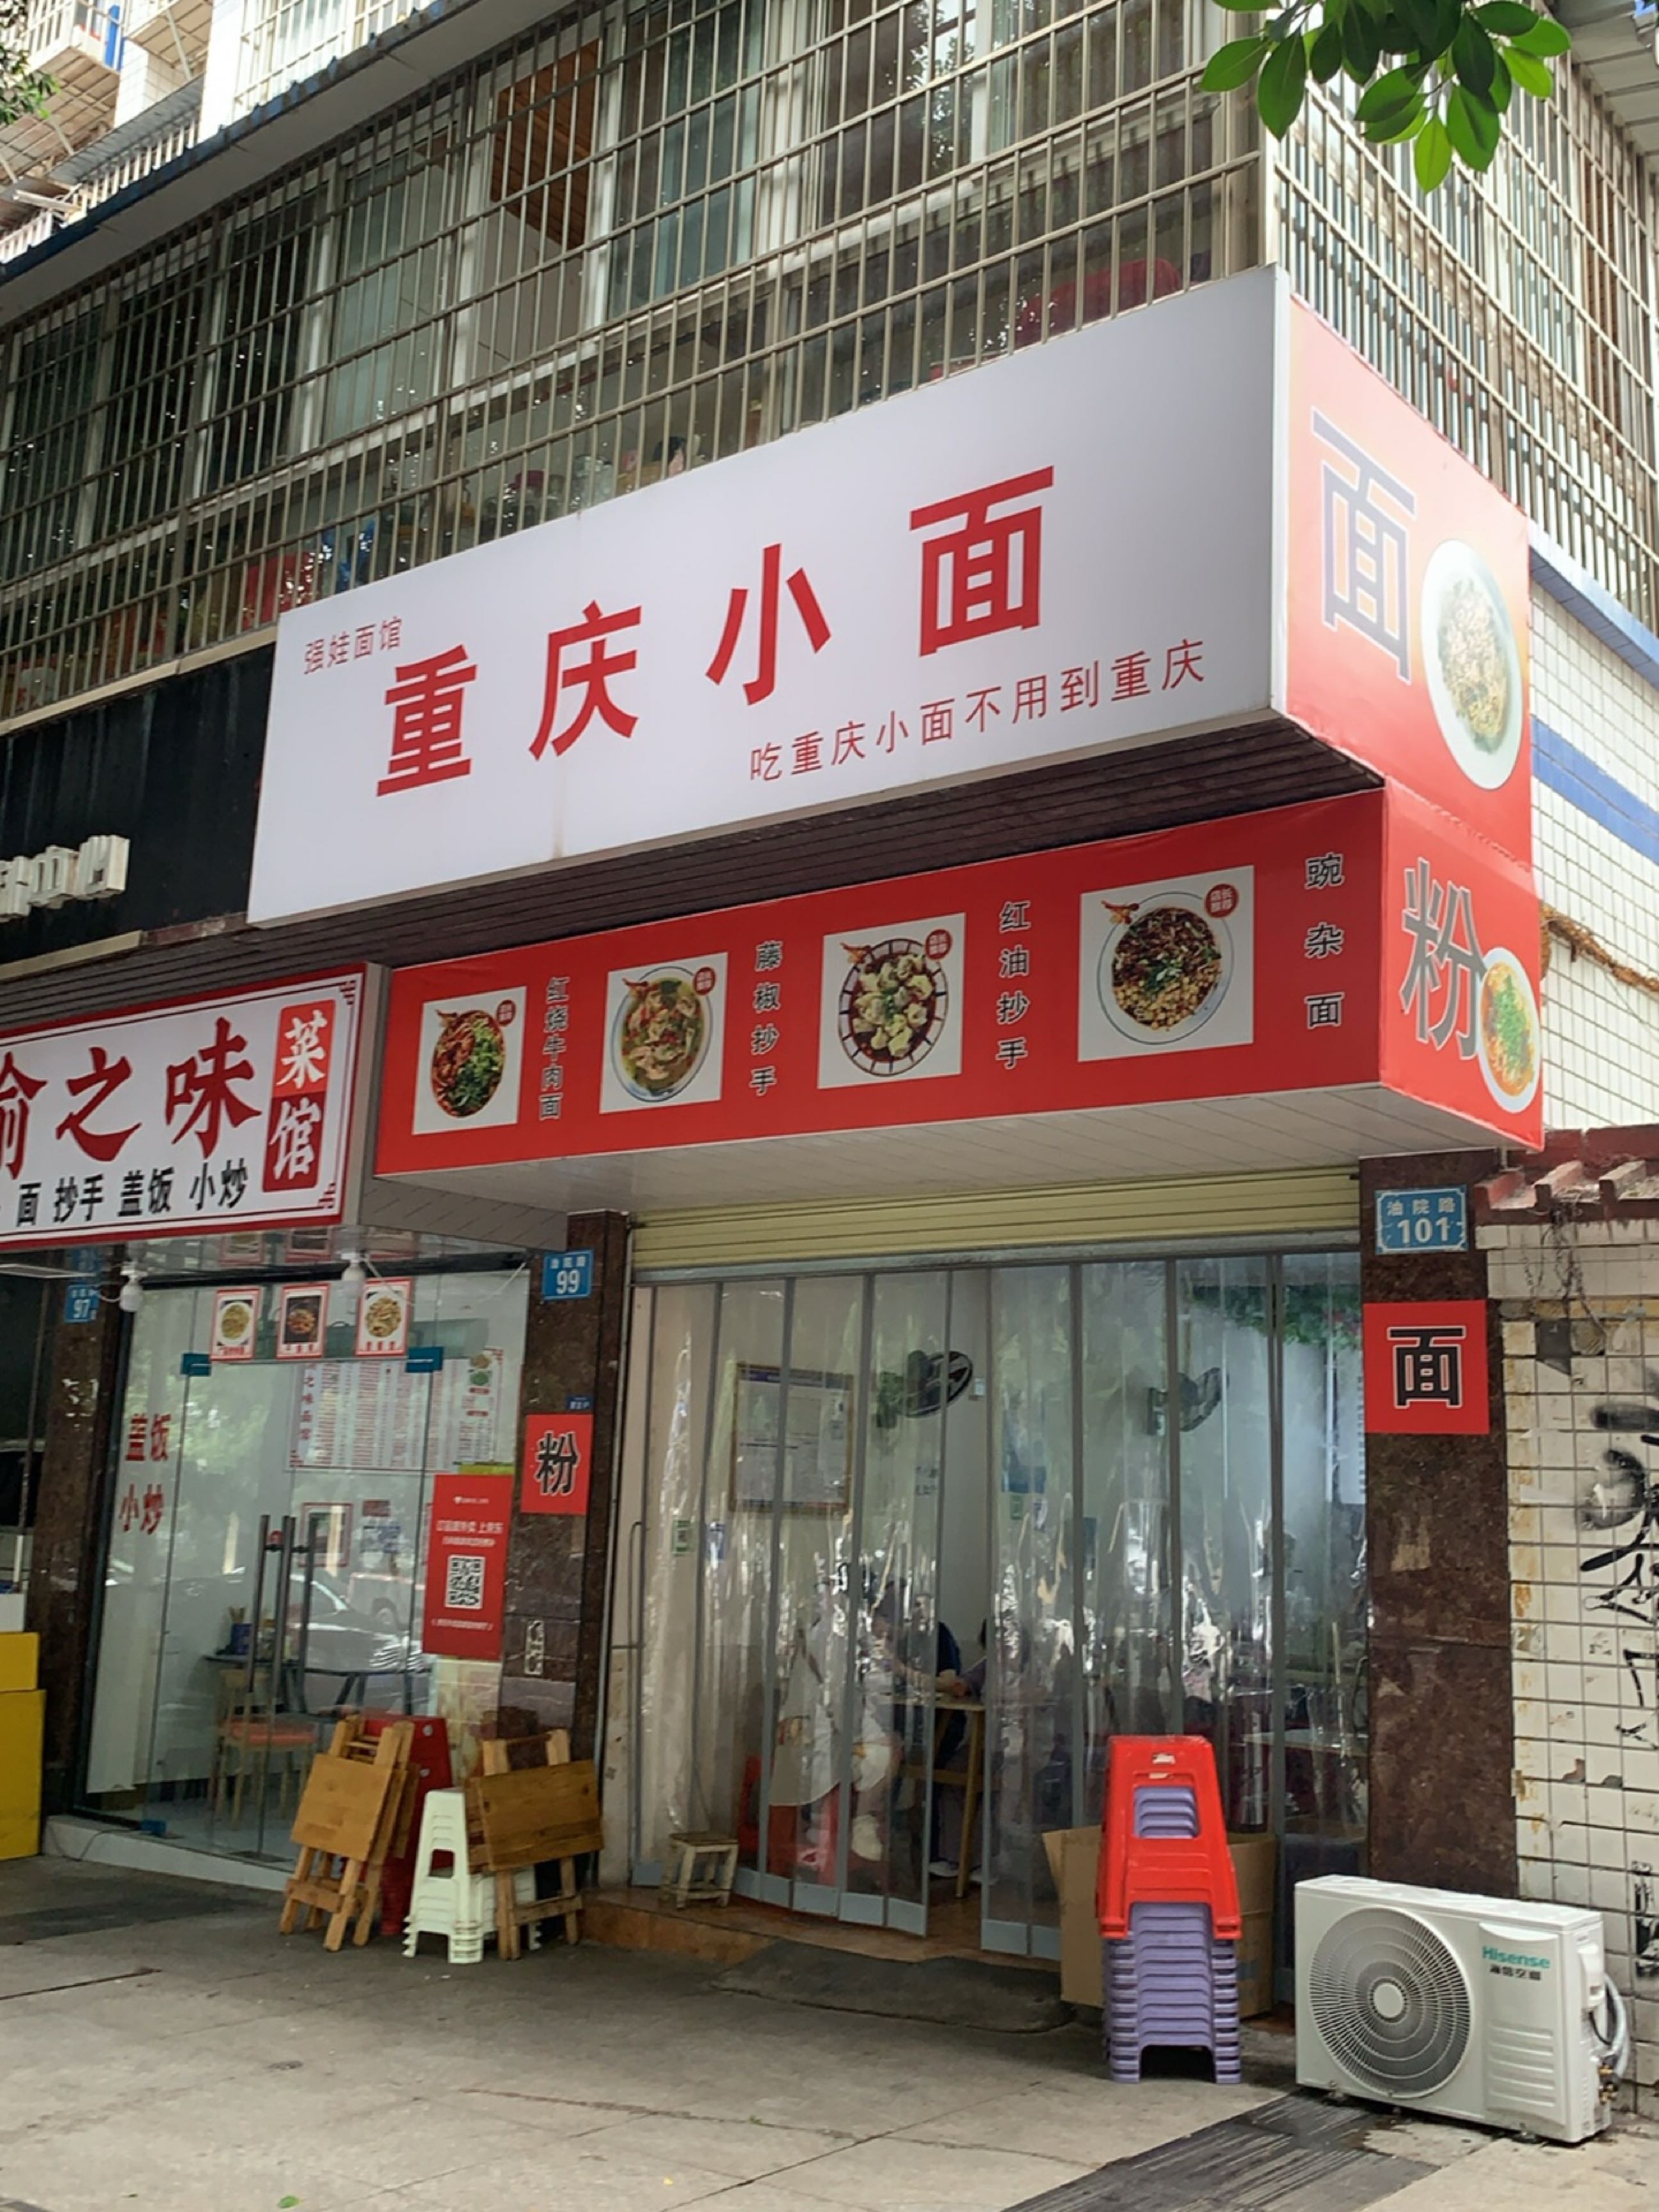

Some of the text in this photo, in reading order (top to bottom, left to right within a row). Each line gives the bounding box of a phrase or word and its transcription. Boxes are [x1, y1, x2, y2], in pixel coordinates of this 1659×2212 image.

[1310, 405, 1418, 686] 面
[304, 616, 403, 675] 强娃面馆
[376, 466, 1055, 797] 重庆小面
[749, 639, 1205, 781] 吃重庆小面不用到重庆
[1304, 851, 1344, 1030] 豌杂面
[1399, 856, 1486, 1061] 粉
[749, 940, 783, 1097] 藤椒抄手
[995, 901, 1031, 1070] 红油抄手
[539, 976, 570, 1121] 红烧牛肉面
[269, 1009, 328, 1181] 菜馆
[17, 1157, 248, 1227] 面 抄手 盖饭 小炒
[1397, 1216, 1451, 1244] 101
[73, 1298, 92, 1319] 97
[556, 1269, 581, 1294] 99
[1387, 1326, 1466, 1409] 面
[125, 1413, 172, 1462] 盖饭
[534, 1429, 581, 1496] 粉
[118, 1483, 165, 1535] 小炒
[1482, 1945, 1551, 1969] Hisense
